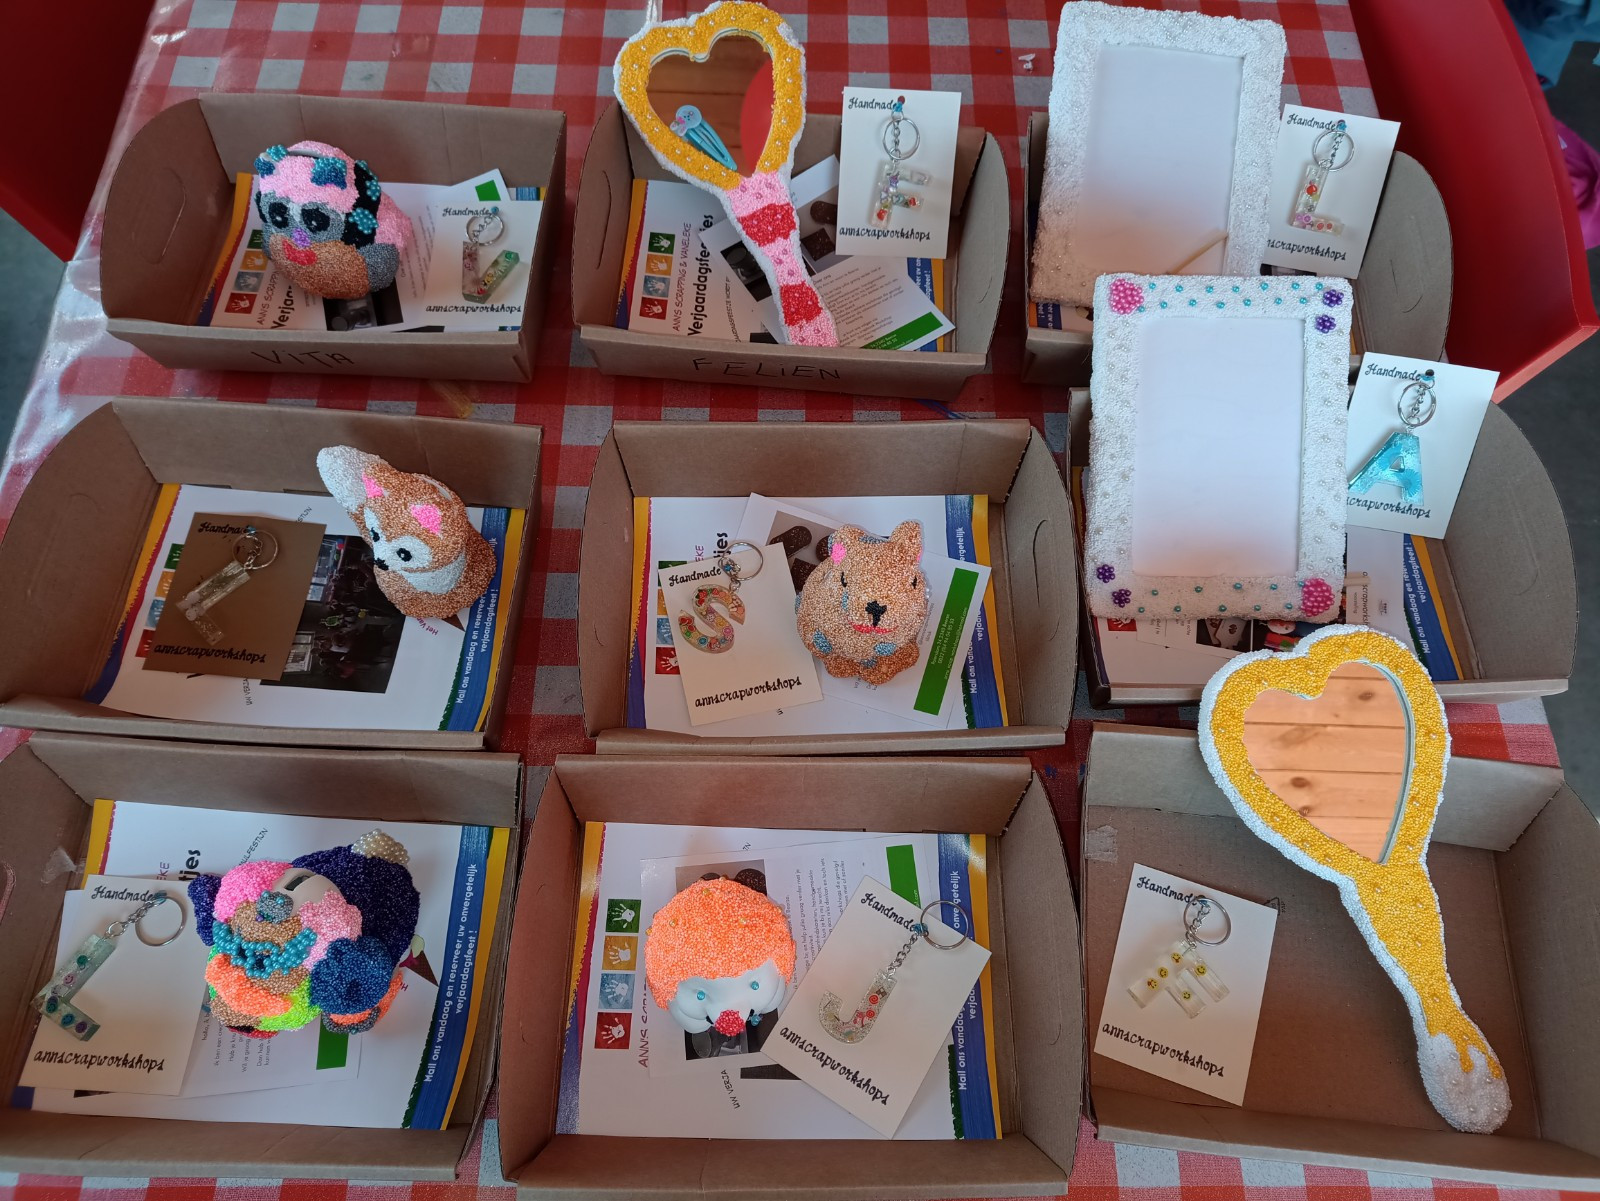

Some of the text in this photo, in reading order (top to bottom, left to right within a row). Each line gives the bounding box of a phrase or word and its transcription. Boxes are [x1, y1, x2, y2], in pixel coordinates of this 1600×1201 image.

[1287, 114, 1336, 132] Handmade
[442, 206, 492, 218] Handmade
[839, 227, 930, 242] annscrapworkshops
[1266, 238, 1347, 262] scrapworkshops
[1365, 363, 1421, 382] Handmade
[1346, 497, 1432, 518] scrapworkshops
[669, 566, 722, 587] Handmade
[694, 676, 802, 707] annscrapworkshops
[950, 870, 962, 928] onvegetelijk
[424, 864, 478, 1082] Mail ons vandaag en reserveer uw onvergetelijk
[456, 936, 476, 1014] verjaardagsfeest
[35, 1049, 164, 1073] annscrapworkshops
[1102, 1022, 1225, 1077] annscrapworkshops
[779, 1027, 889, 1106] annscrapworkshops
[720, 1069, 734, 1094] VERJA
[957, 1070, 967, 1090] Mail
